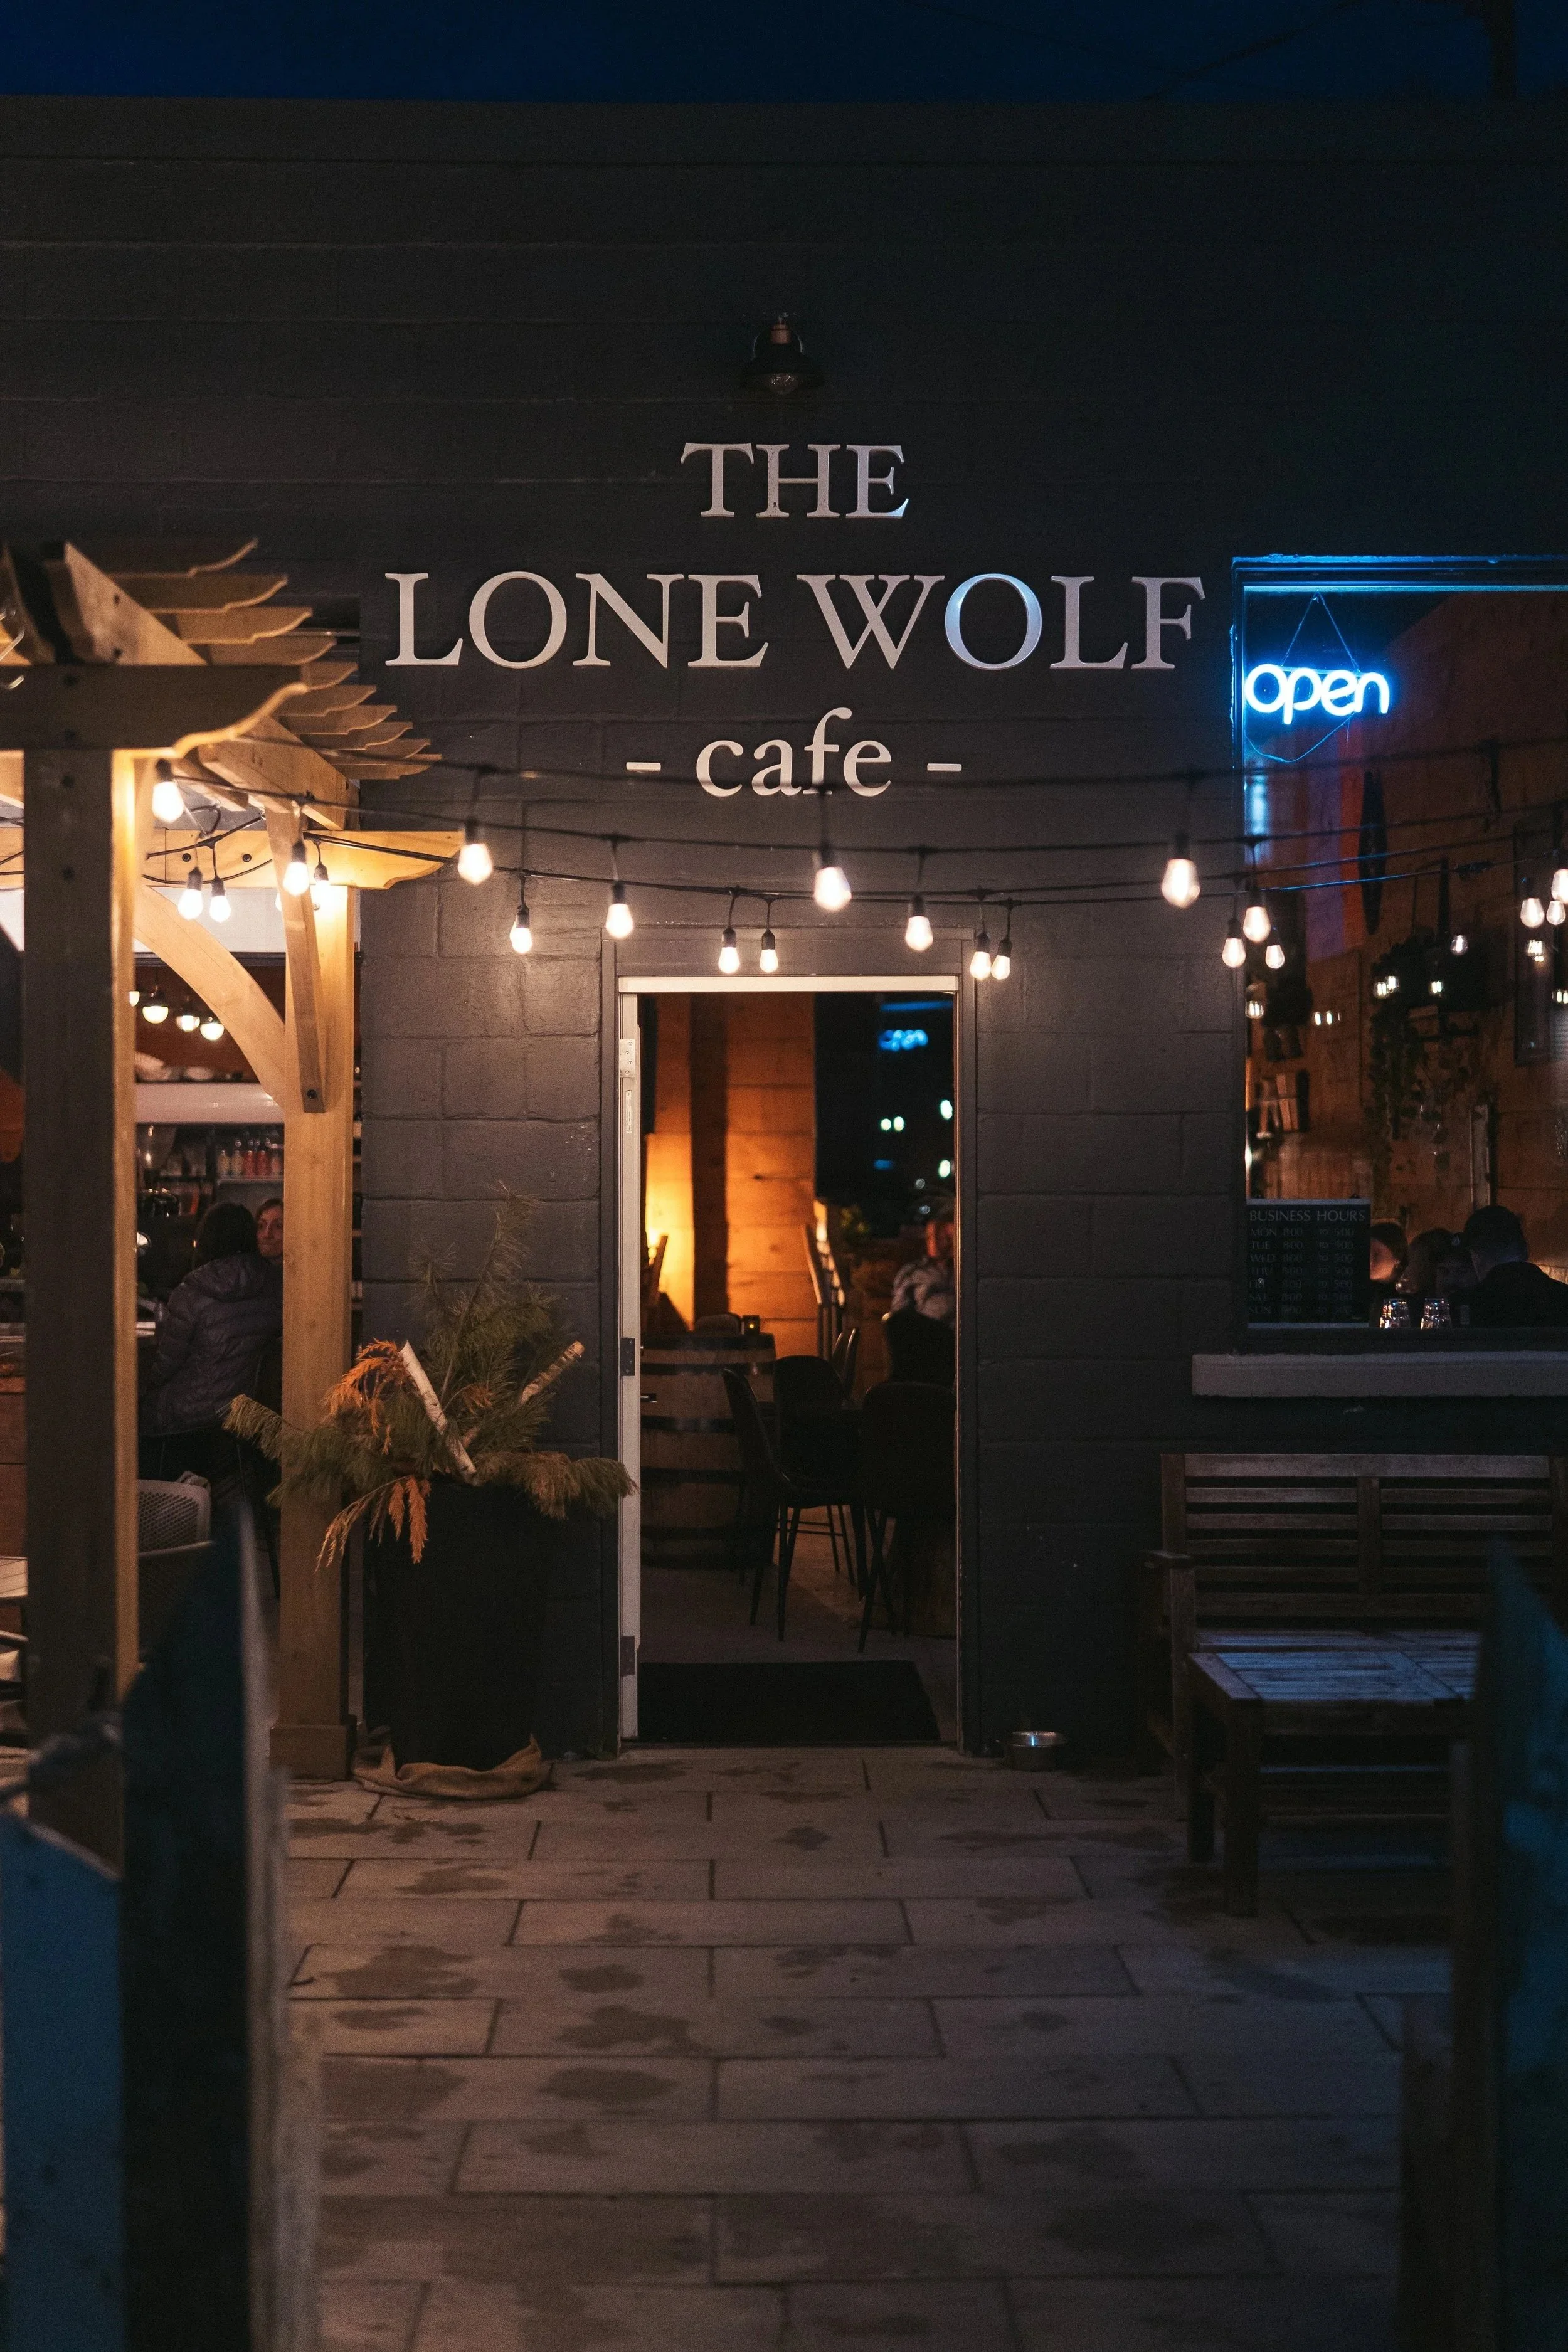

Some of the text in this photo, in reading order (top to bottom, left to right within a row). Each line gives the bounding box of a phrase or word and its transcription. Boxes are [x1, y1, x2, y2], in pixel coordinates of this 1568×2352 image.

[679, 442, 910, 520] THE
[384, 570, 1206, 671] LONE WOLF
[1244, 664, 1390, 724] open
[695, 706, 893, 802] cafe
[1249, 1210, 1365, 1222] BUSINESS HOURS
[1251, 1227, 1277, 1236] MON
[1252, 1241, 1271, 1249] TUE
